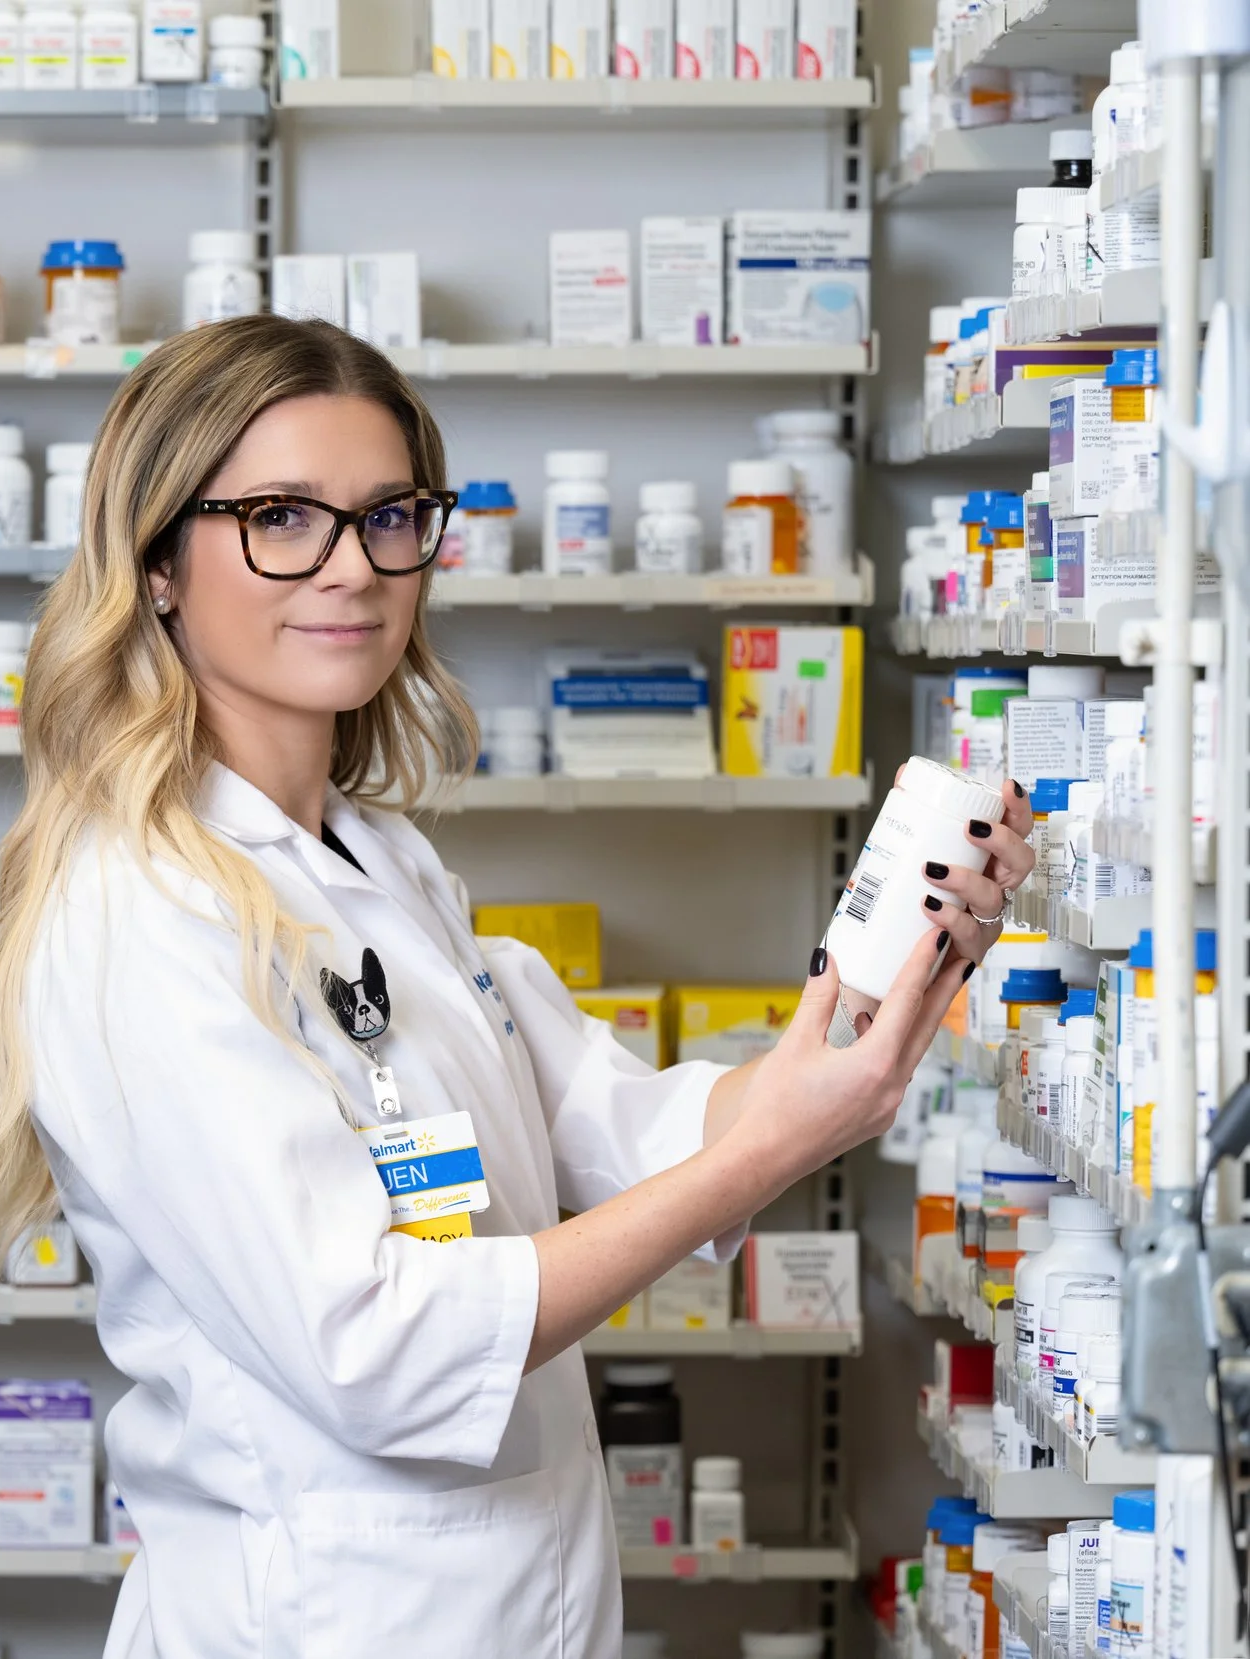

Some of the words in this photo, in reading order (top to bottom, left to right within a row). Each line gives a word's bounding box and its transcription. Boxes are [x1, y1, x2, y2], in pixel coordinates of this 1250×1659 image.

[369, 1138, 417, 1158] almart
[386, 1162, 429, 1192] JEN
[413, 1191, 470, 1213] Difference
[1076, 1557, 1093, 1566] Topical
